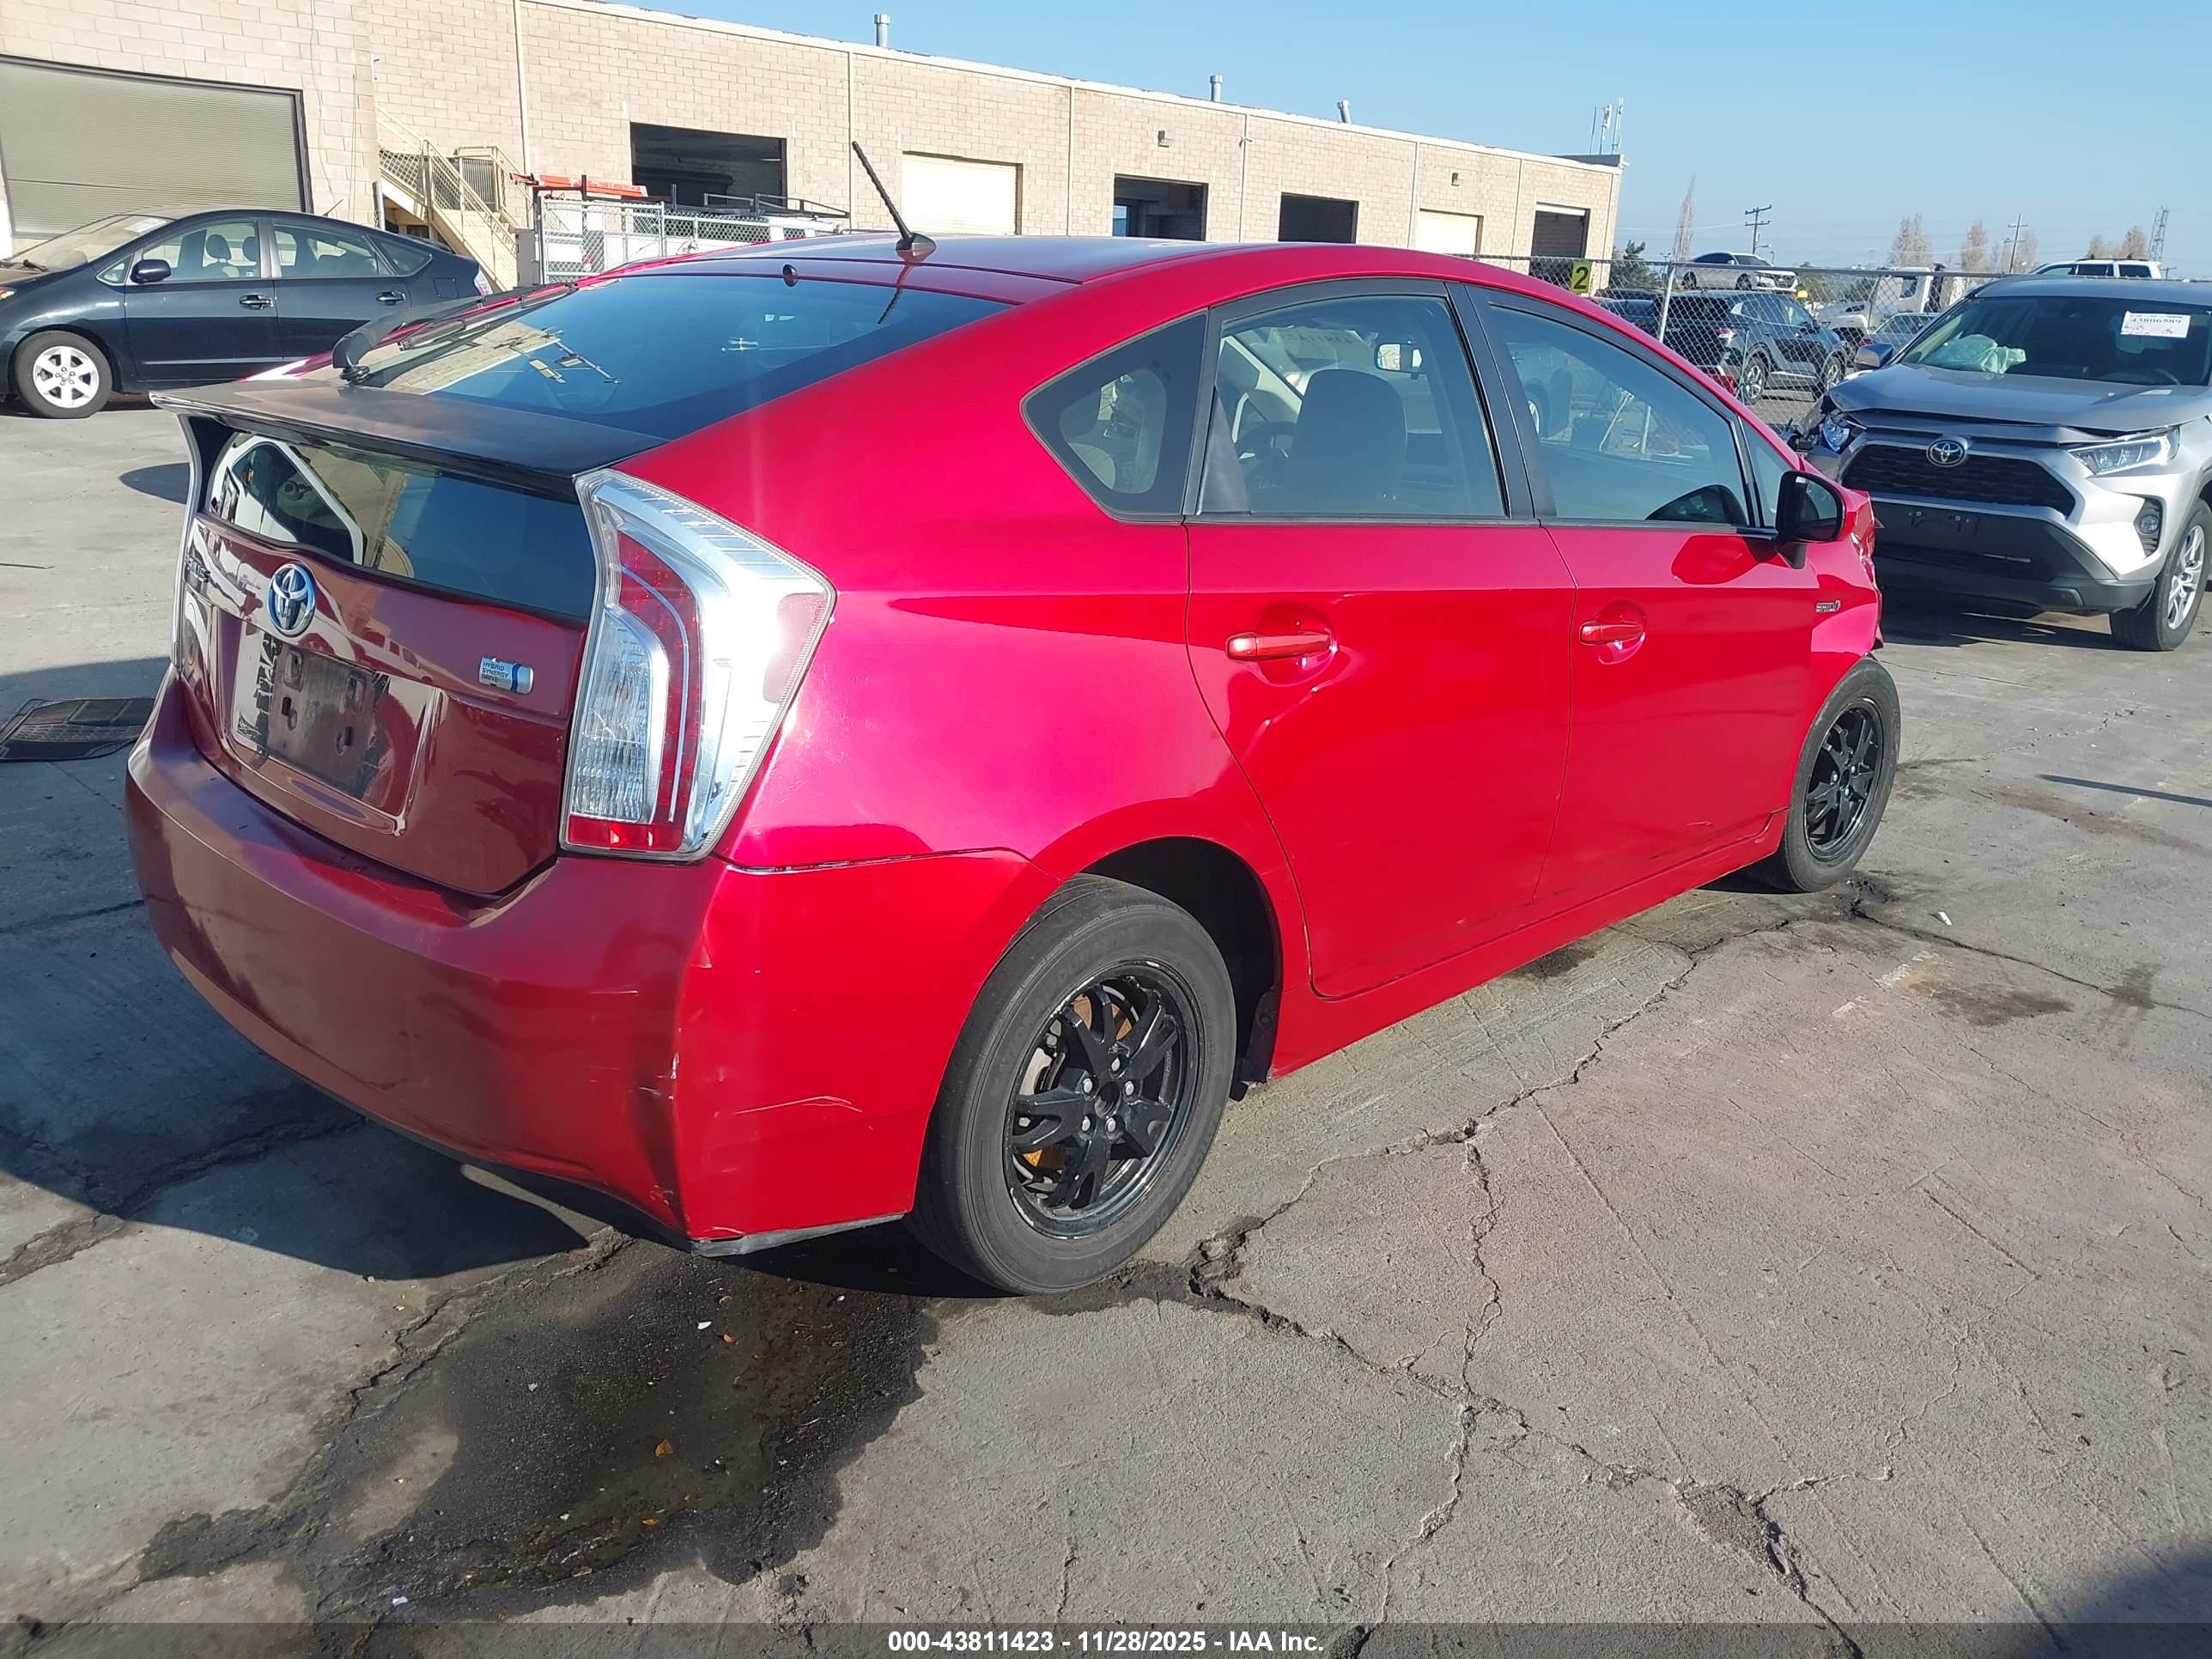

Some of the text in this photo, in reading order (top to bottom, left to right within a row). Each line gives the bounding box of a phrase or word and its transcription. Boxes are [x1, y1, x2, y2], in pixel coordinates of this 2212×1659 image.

[1573, 266, 1589, 289] 2
[483, 662, 505, 672] HYBRID
[482, 667, 509, 678] SYNERGY
[481, 674, 499, 683] DRIVE
